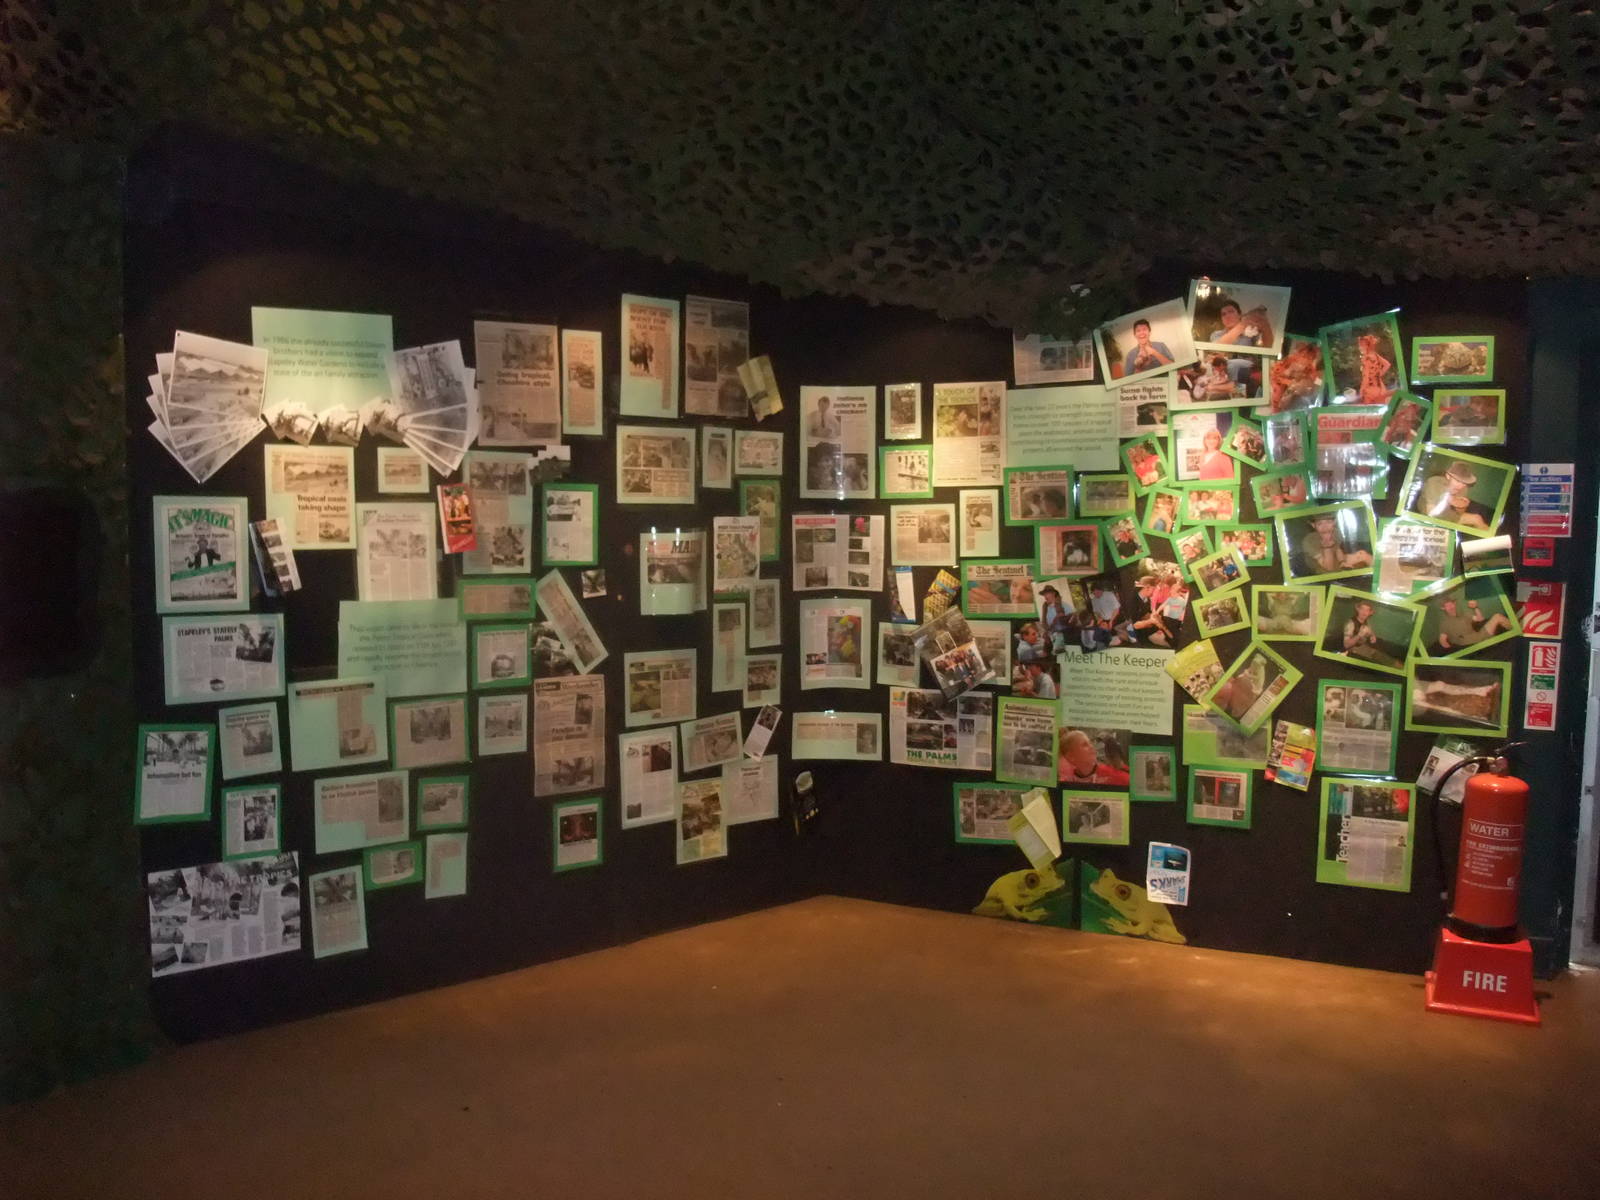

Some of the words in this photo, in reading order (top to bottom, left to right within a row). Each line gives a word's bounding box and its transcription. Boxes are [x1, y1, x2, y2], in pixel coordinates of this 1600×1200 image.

[298, 504, 322, 513] taking
[324, 504, 346, 512] shape
[976, 566, 991, 574] The
[993, 566, 1024, 574] Sentinel
[1064, 651, 1094, 664] Meet
[1099, 652, 1120, 666] The
[1124, 653, 1167, 669] Keeper
[907, 750, 922, 759] THE
[925, 751, 957, 761] PALMS
[1469, 822, 1510, 838] WATER
[1462, 970, 1508, 993] FIRE
